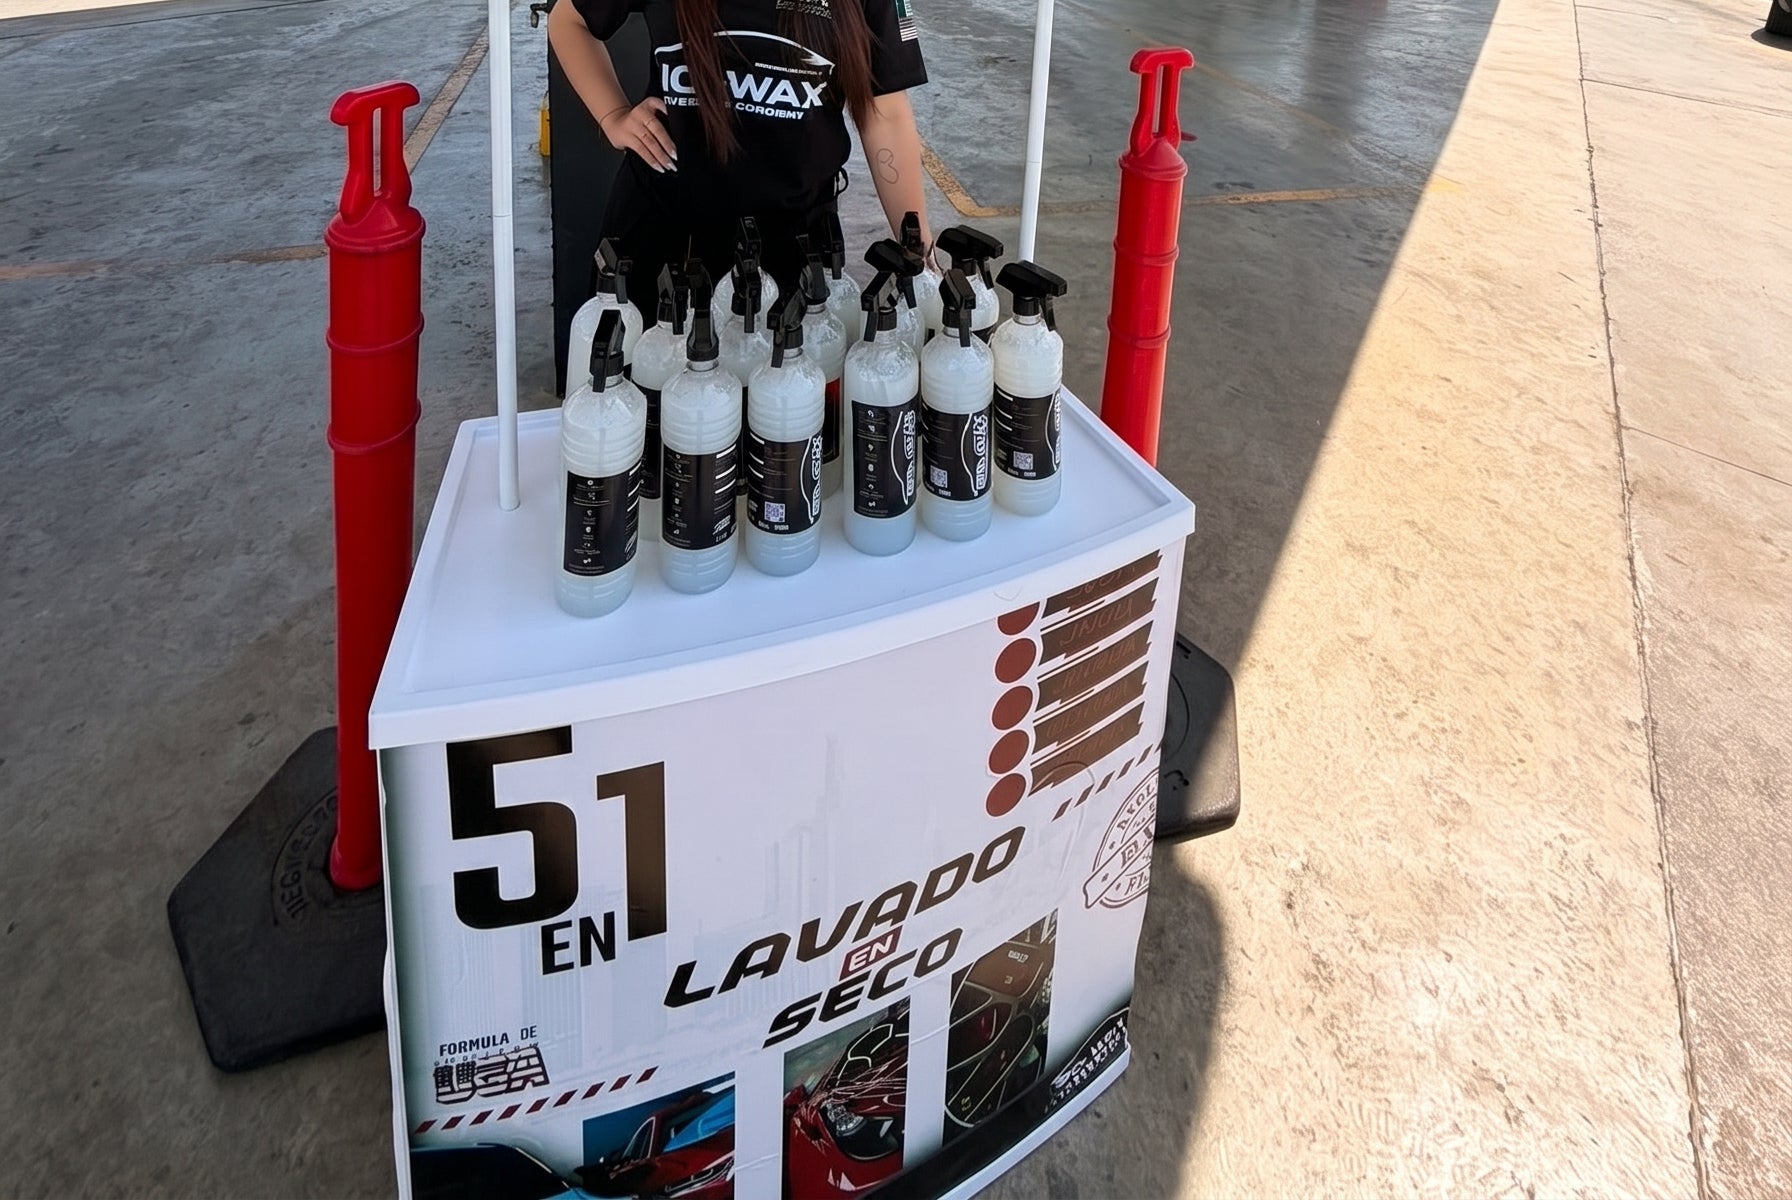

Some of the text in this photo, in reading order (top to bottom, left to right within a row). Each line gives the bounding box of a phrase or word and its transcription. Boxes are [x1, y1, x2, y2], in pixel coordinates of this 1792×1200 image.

[662, 63, 828, 109] ICWAX
[446, 724, 579, 930] 5
[541, 911, 616, 976] EN
[597, 761, 667, 941] 1
[663, 826, 1026, 1008] LAVADO
[849, 937, 894, 973] EN
[762, 928, 963, 1049] SECO
[440, 1032, 510, 1057] FORMULA
[520, 1025, 538, 1040] DE
